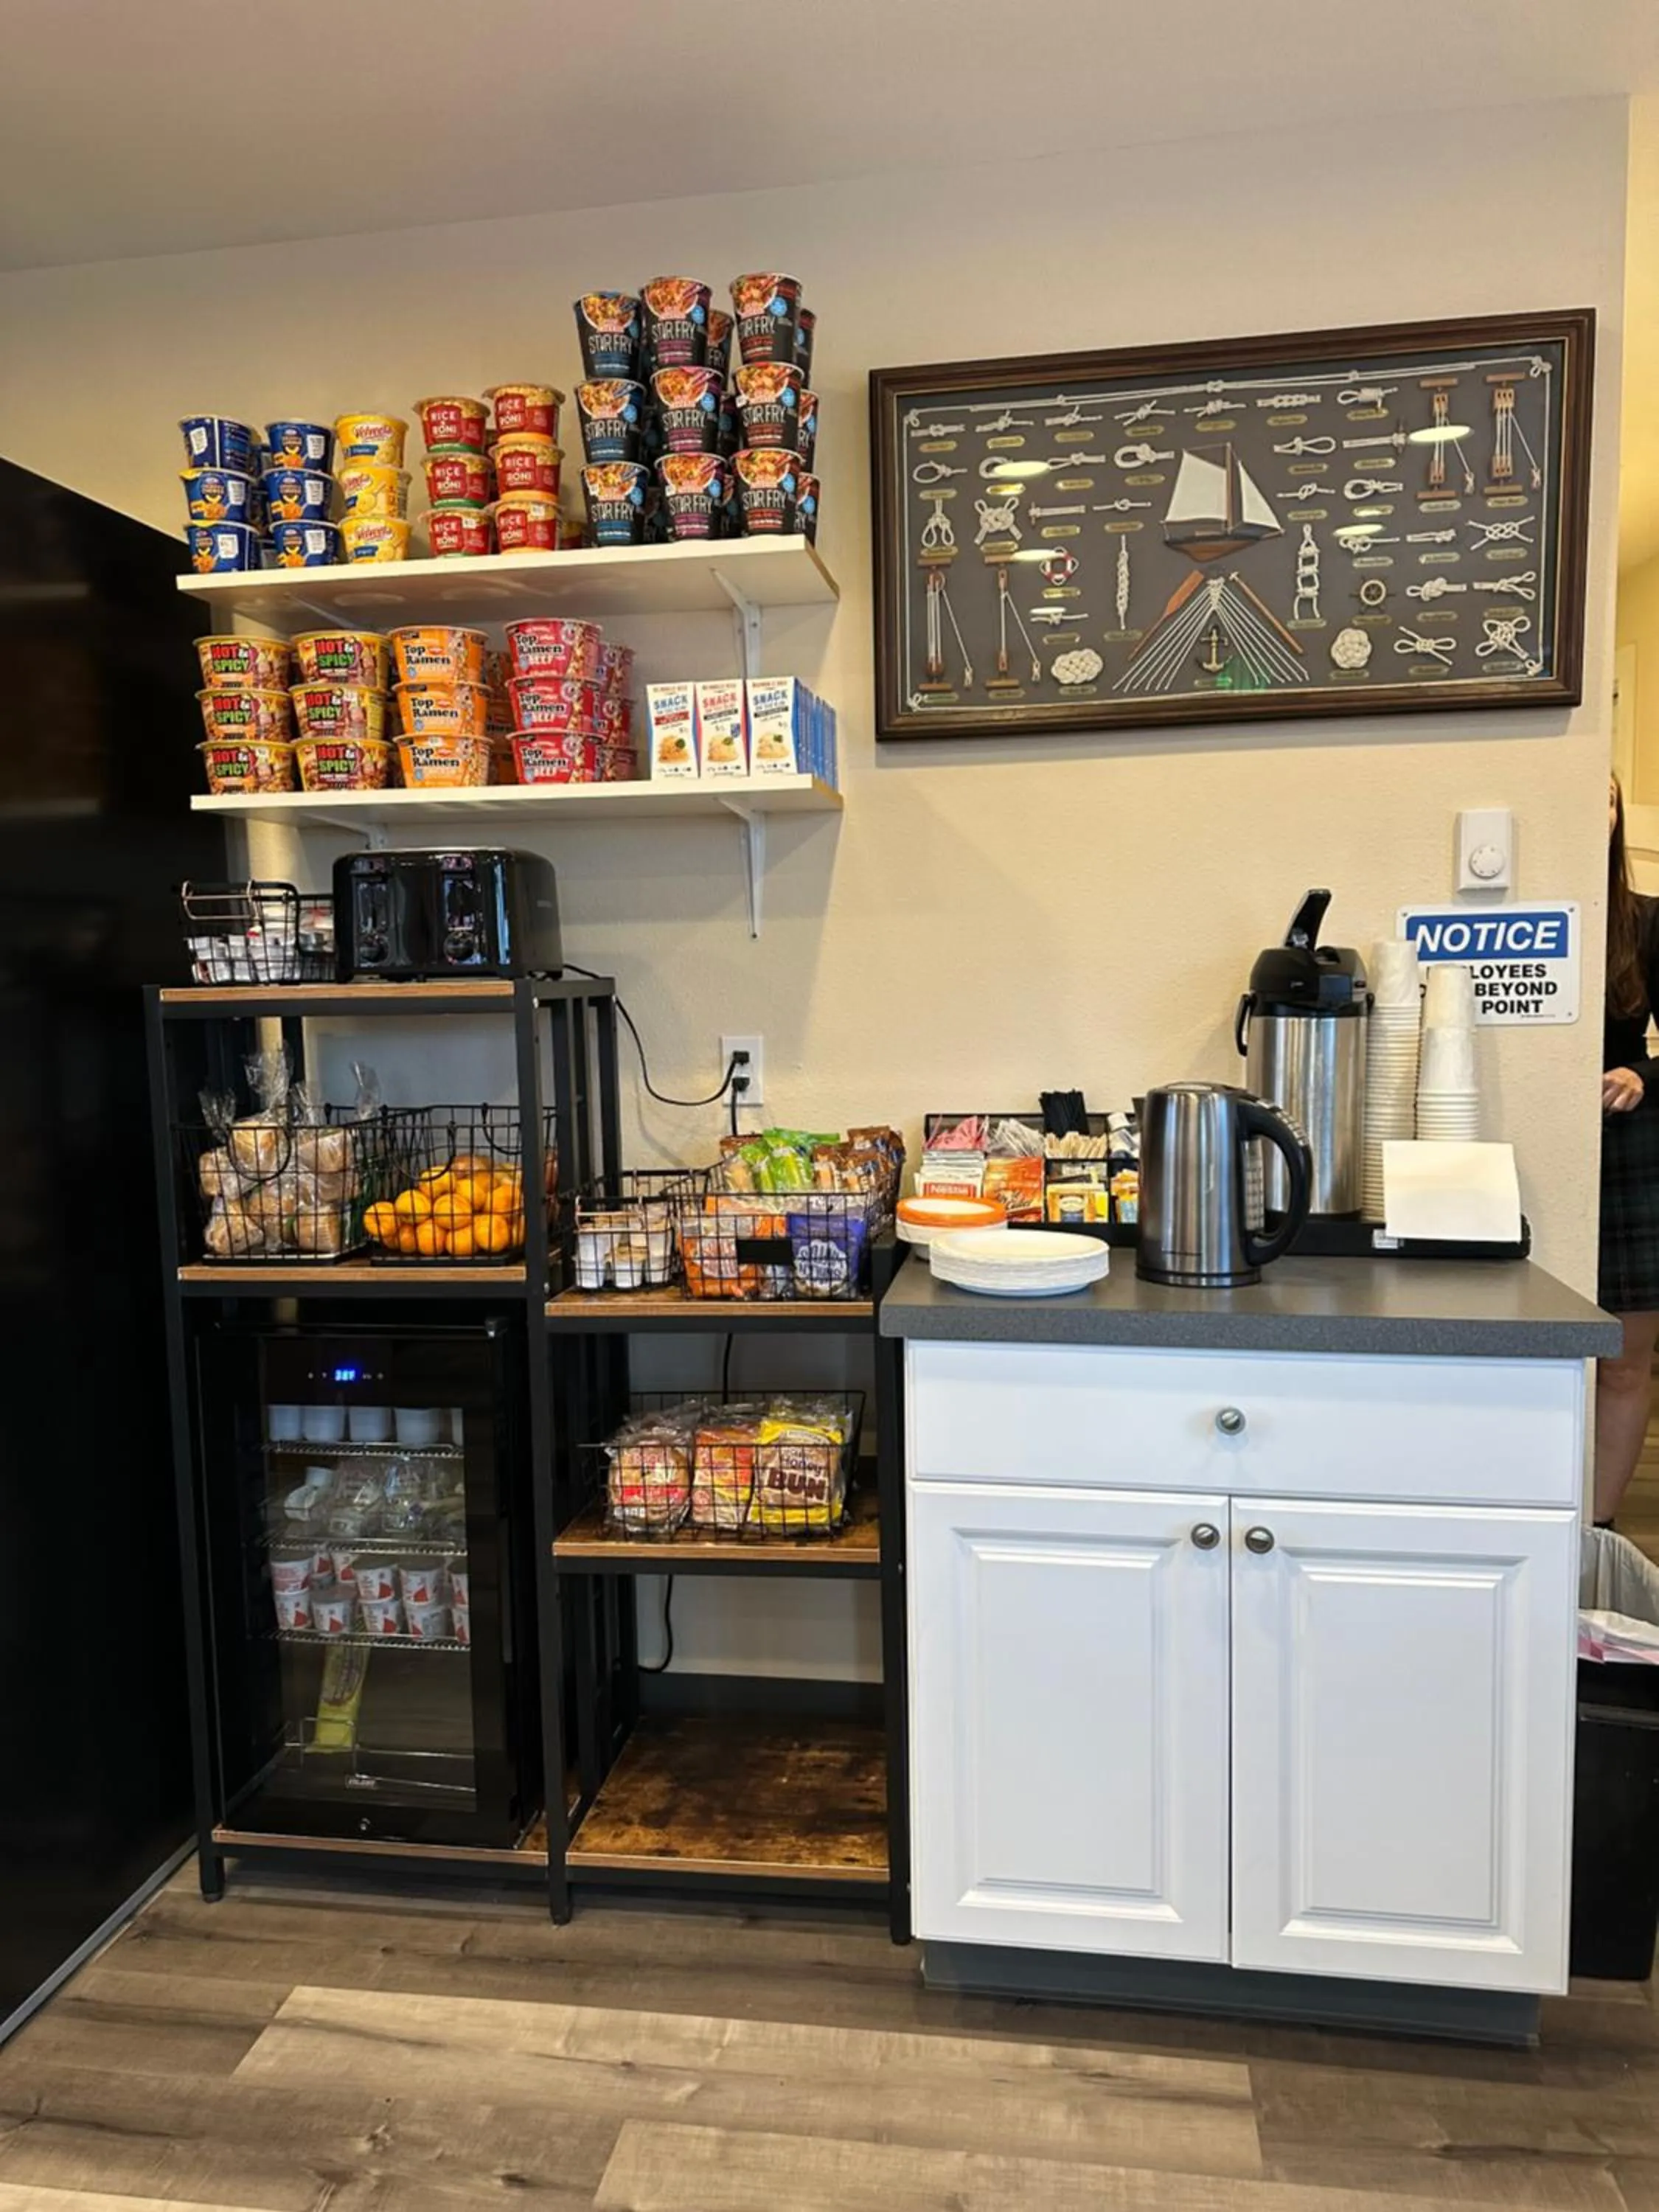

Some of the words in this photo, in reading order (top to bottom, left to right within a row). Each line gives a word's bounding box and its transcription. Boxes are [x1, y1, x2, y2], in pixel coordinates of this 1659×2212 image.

[663, 411, 683, 431] STIR
[686, 411, 706, 428] FRY
[742, 408, 762, 426] STIR
[765, 406, 787, 422] FRY
[585, 420, 605, 440] STIR
[608, 420, 627, 437] FRY
[669, 496, 690, 515] STIR
[693, 495, 712, 513] FRY
[742, 490, 763, 510] STIR
[766, 490, 787, 507] FRY
[591, 502, 613, 521] STIR
[614, 502, 634, 521] FRY
[517, 635, 537, 645] Top
[212, 645, 237, 658] HOT
[316, 641, 344, 654] HOT
[403, 644, 425, 655] Top
[518, 645, 563, 654] Ramen
[212, 660, 248, 672] SPICY
[318, 655, 355, 667] SPICY
[406, 655, 451, 665] Ramen
[305, 693, 332, 706] HOT
[411, 698, 434, 709] Top
[520, 692, 540, 703] Top
[213, 698, 240, 711] HOT
[522, 703, 565, 712] Ramen
[215, 711, 251, 723] SPICY
[307, 706, 342, 720] SPICY
[413, 709, 459, 718] Ramen
[212, 750, 237, 762] HOT
[317, 747, 345, 760] HOT
[411, 746, 434, 758] Top
[522, 748, 542, 759] Top
[319, 760, 355, 773] SPICY
[413, 757, 459, 767] Ramen
[524, 758, 567, 768] Ramen
[215, 763, 248, 776] SPICY
[1416, 920, 1561, 953] NOTICE
[1463, 963, 1547, 979] LOYEES
[1475, 982, 1558, 997] BEYOND
[1481, 999, 1543, 1015] POINT
[768, 1468, 827, 1501] BUN
